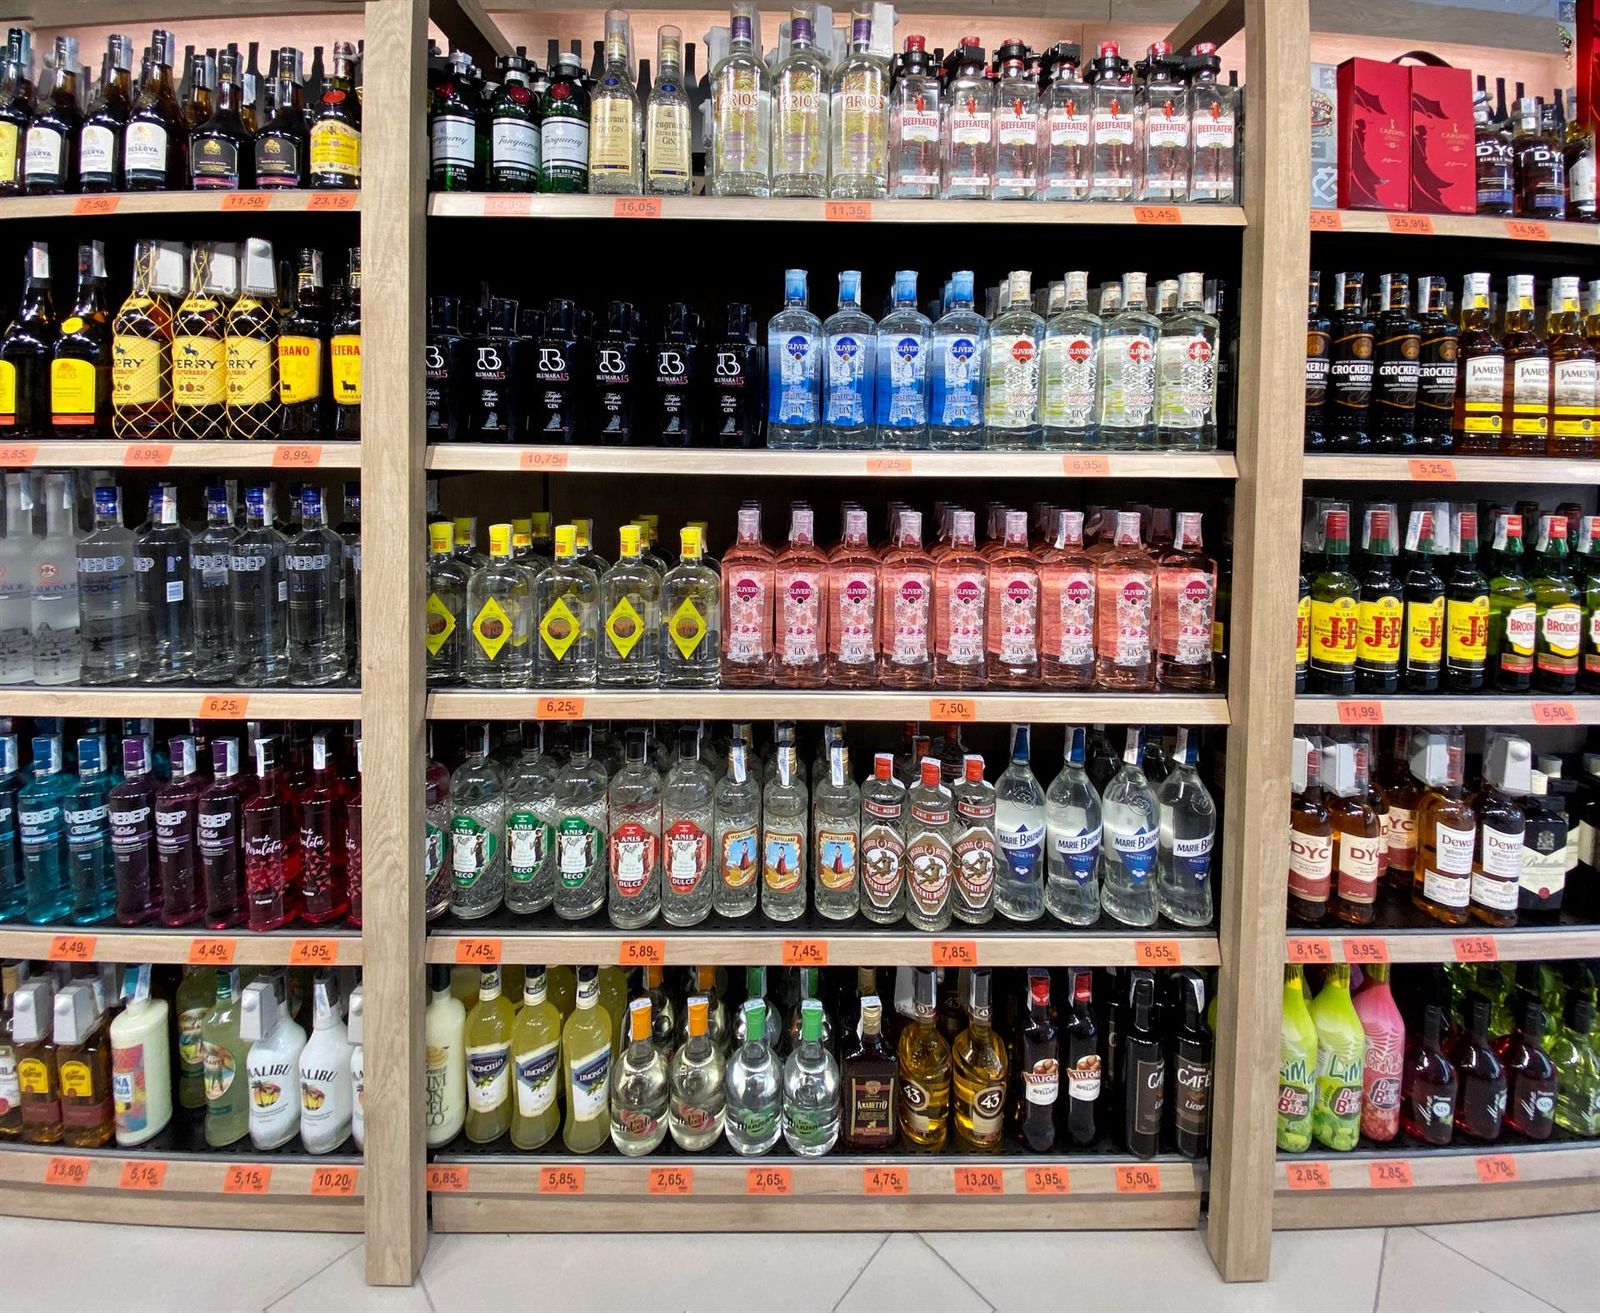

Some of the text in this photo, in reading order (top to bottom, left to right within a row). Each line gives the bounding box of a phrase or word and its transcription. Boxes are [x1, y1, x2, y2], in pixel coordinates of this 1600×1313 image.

[903, 117, 938, 129] BEEFEATER
[954, 119, 989, 130] BEEFEATER
[1001, 121, 1036, 131] BEEFEATER
[1052, 122, 1088, 132] BEEFEATER
[1096, 121, 1133, 131] BEEFEATER
[1150, 123, 1186, 133] BEEFEATER
[1197, 124, 1233, 134] BEEFEATER
[513, 823, 533, 831] ANIS
[1388, 815, 1415, 831] YC
[454, 827, 474, 835] ANIS
[563, 828, 584, 836] ANIS
[674, 833, 694, 841] ANIS
[999, 834, 1018, 846] MARIE
[1114, 837, 1136, 847] MARIE
[1057, 839, 1079, 849] MARIE
[1176, 843, 1200, 852] MARIE
[1290, 840, 1329, 860] DYC
[454, 871, 474, 879] SECO
[512, 866, 533, 874] SECO
[562, 872, 584, 880] SECO
[618, 880, 641, 888] DULCE
[672, 878, 695, 886] DULCE
[857, 1100, 888, 1110] AMARETTO
[980, 1093, 1000, 1109] 43
